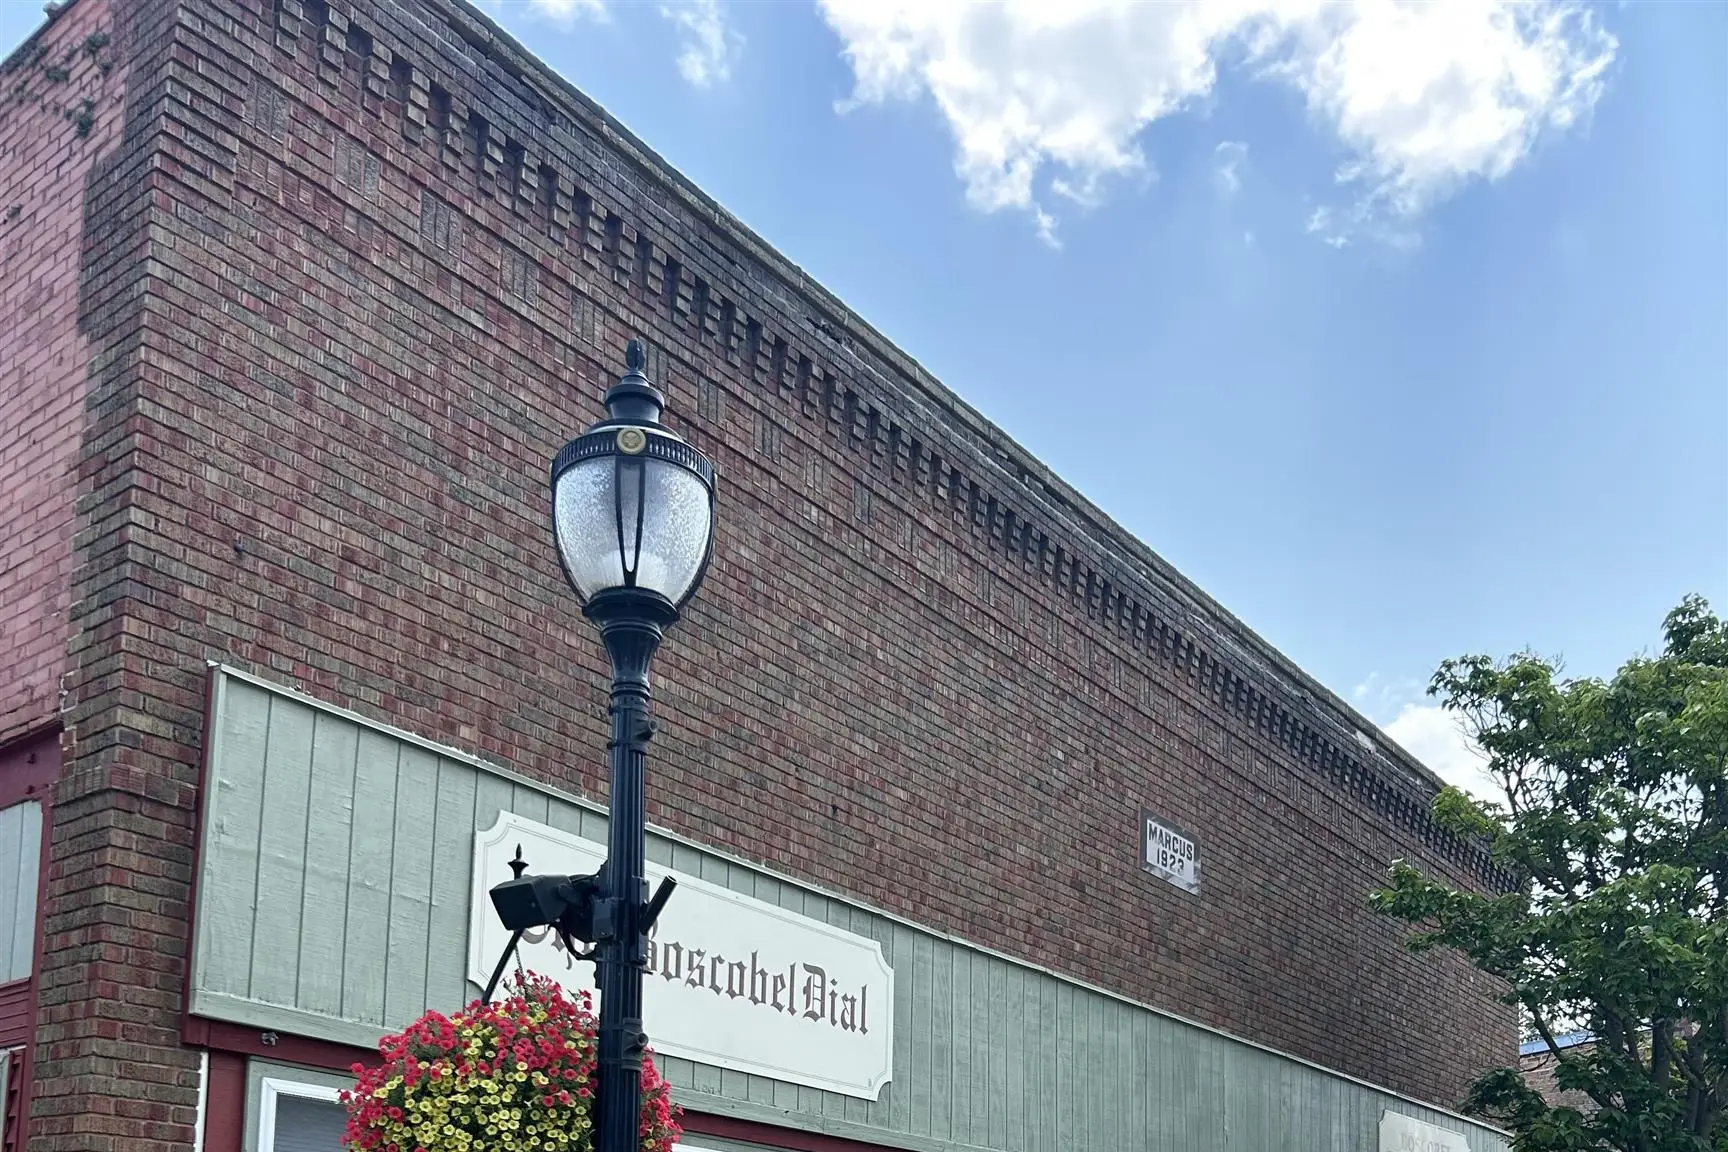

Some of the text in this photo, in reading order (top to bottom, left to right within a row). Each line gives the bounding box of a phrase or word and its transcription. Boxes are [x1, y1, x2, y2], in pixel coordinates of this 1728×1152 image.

[1148, 822, 1193, 862] MARCUS
[1157, 848, 1184, 873] 1923
[802, 962, 868, 1035] Dial
